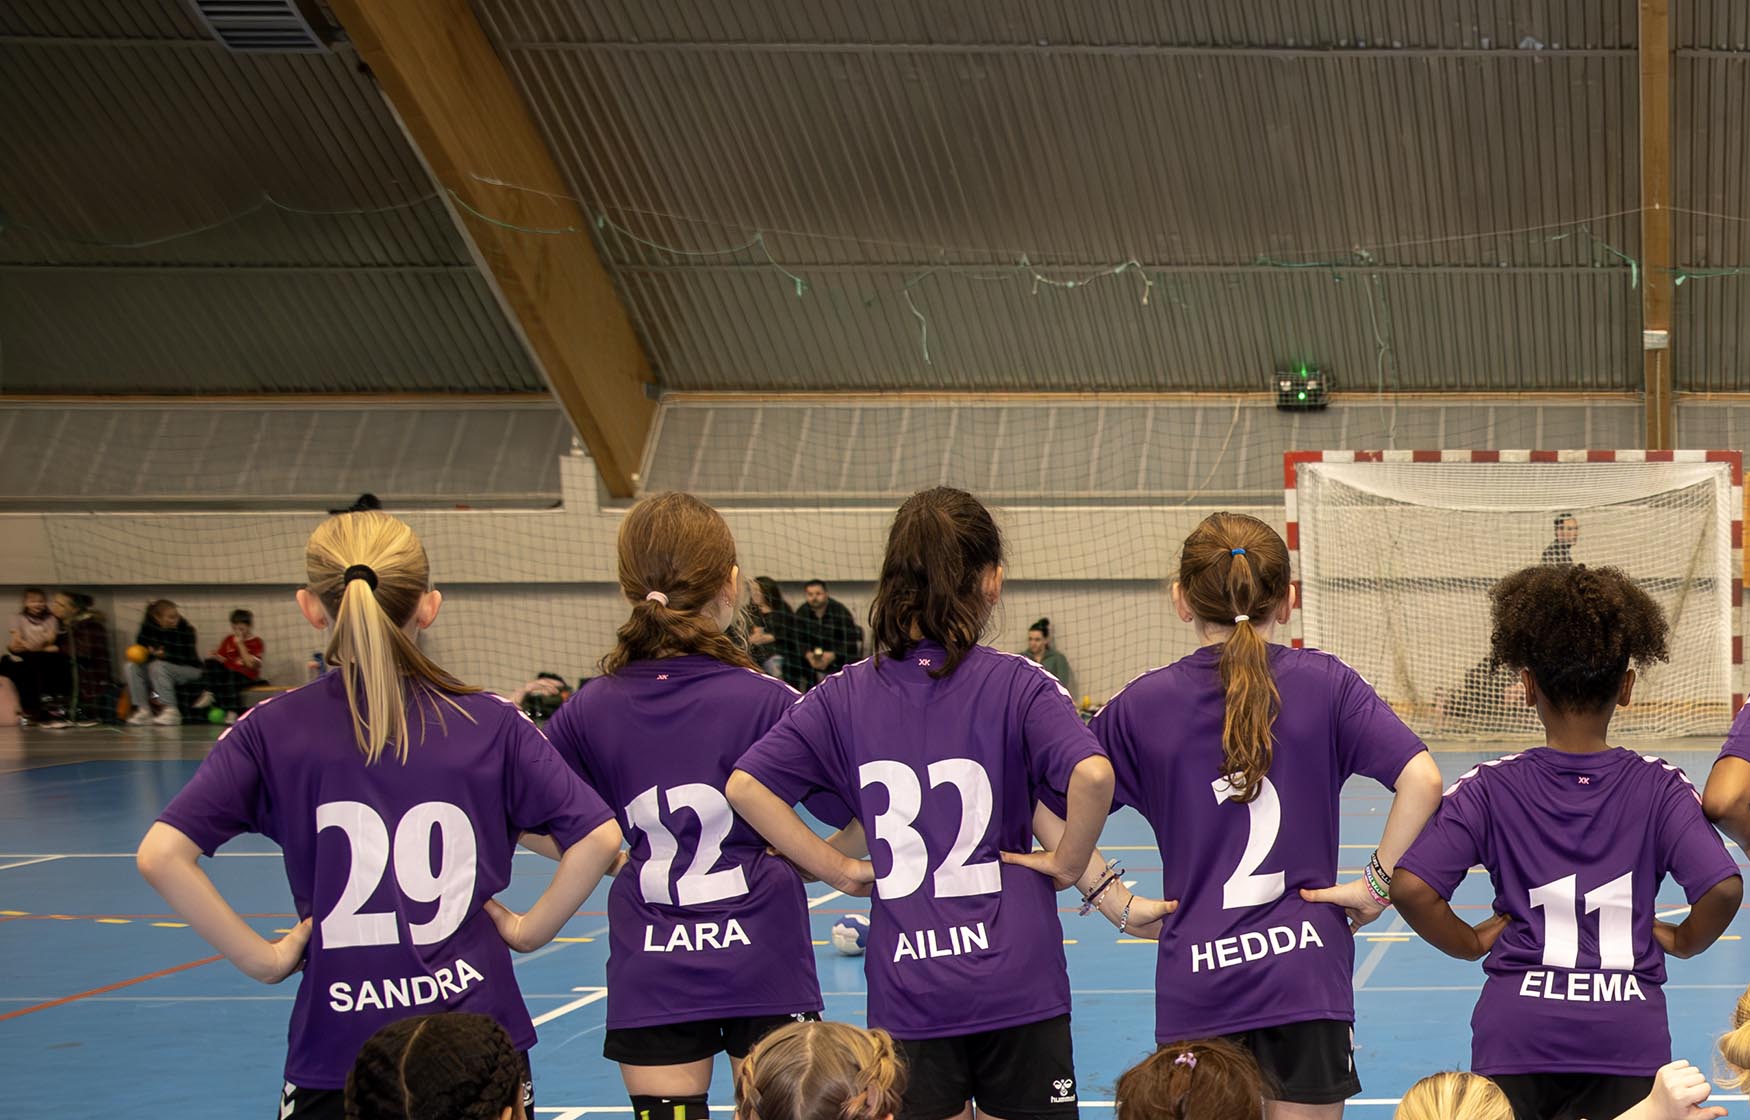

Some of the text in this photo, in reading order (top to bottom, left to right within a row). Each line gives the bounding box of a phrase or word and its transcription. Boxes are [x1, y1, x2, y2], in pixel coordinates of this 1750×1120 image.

[626, 781, 749, 907] 12
[856, 758, 1002, 900] 32
[1211, 771, 1286, 910] 2
[316, 800, 477, 950] 29
[643, 918, 752, 952] LARA
[893, 922, 989, 963] AILIN
[1191, 920, 1324, 973] HEDDA
[1528, 870, 1636, 970] 11
[329, 958, 485, 1012] SANDRA
[1519, 970, 1647, 1002] ELEMA
